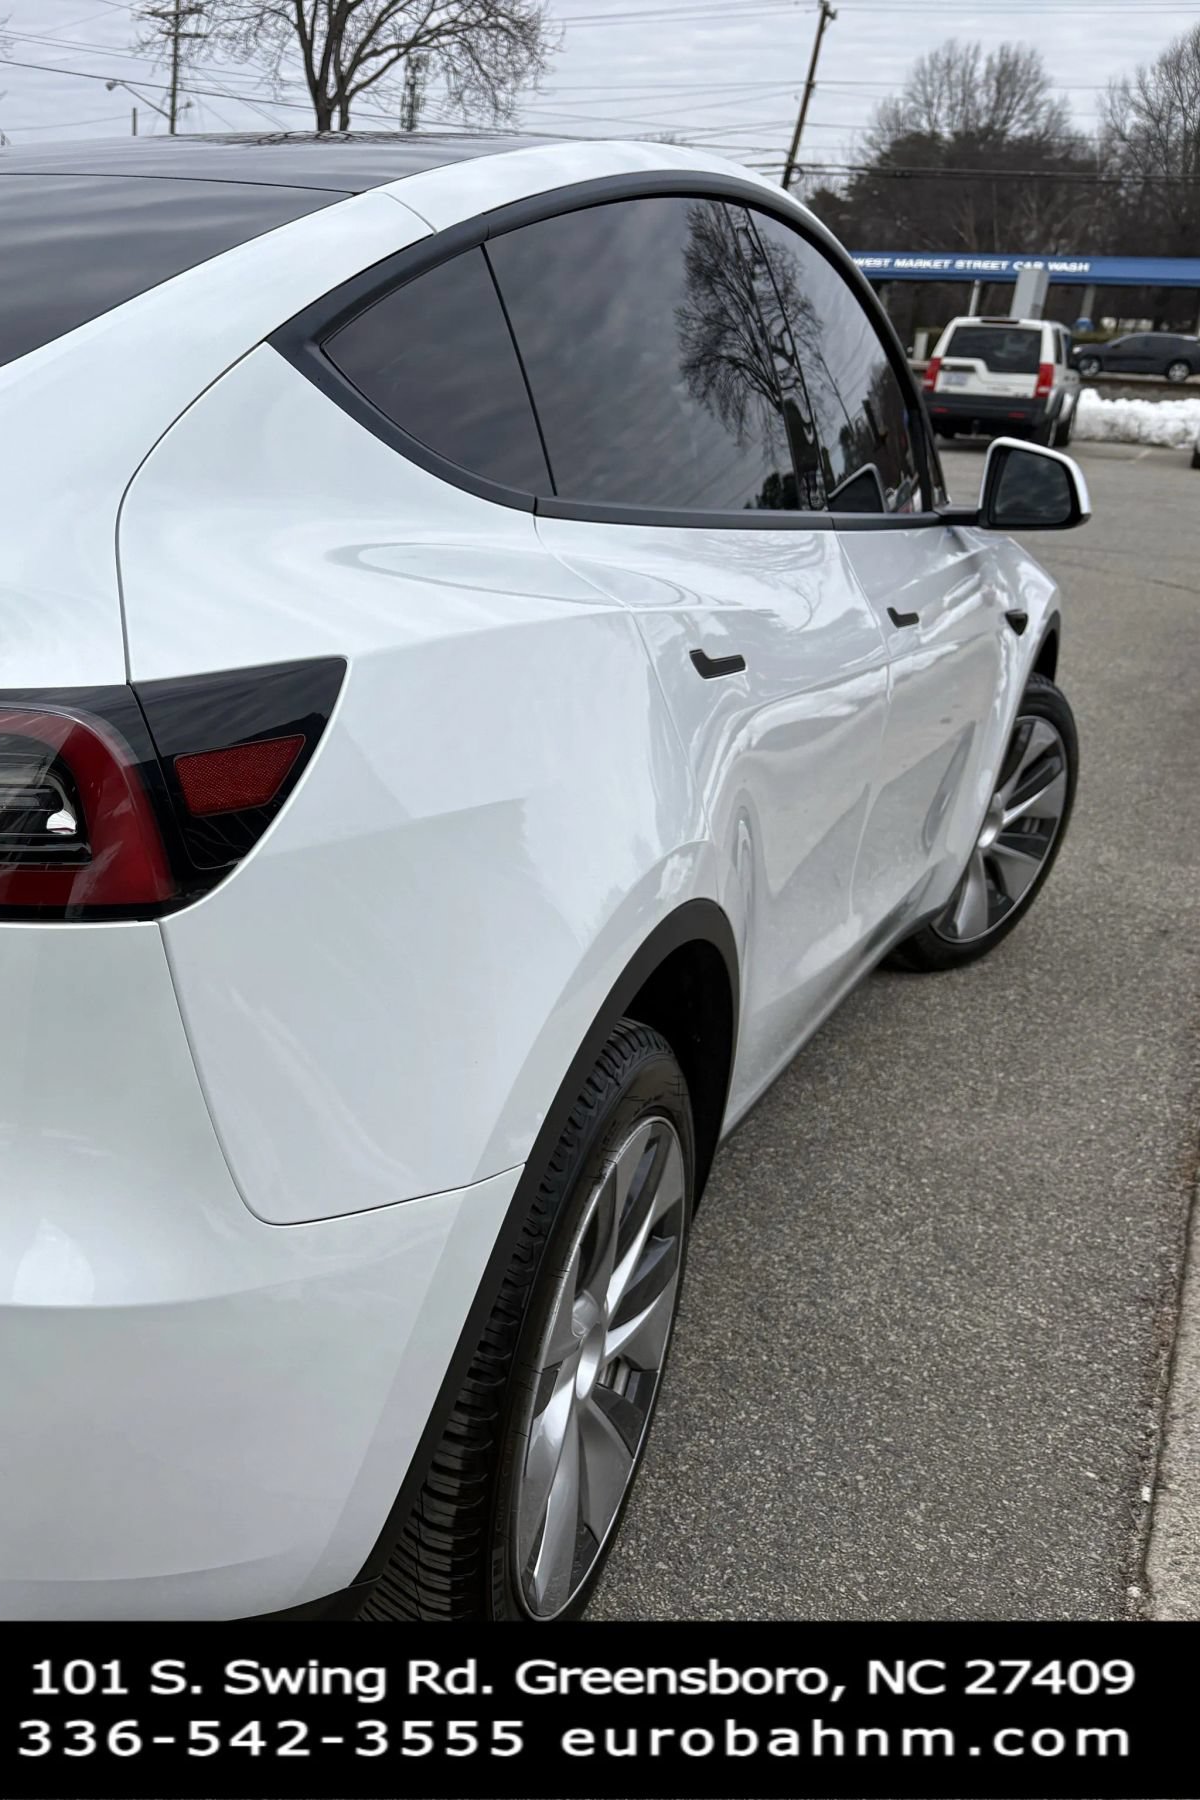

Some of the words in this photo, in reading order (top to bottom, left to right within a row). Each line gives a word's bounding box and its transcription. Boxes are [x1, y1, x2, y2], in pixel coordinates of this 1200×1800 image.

[852, 257, 891, 268] WEST
[894, 258, 951, 270] MARKET
[954, 260, 1009, 271] STREET
[1012, 261, 1044, 271] CAR
[1047, 262, 1090, 273] WASH
